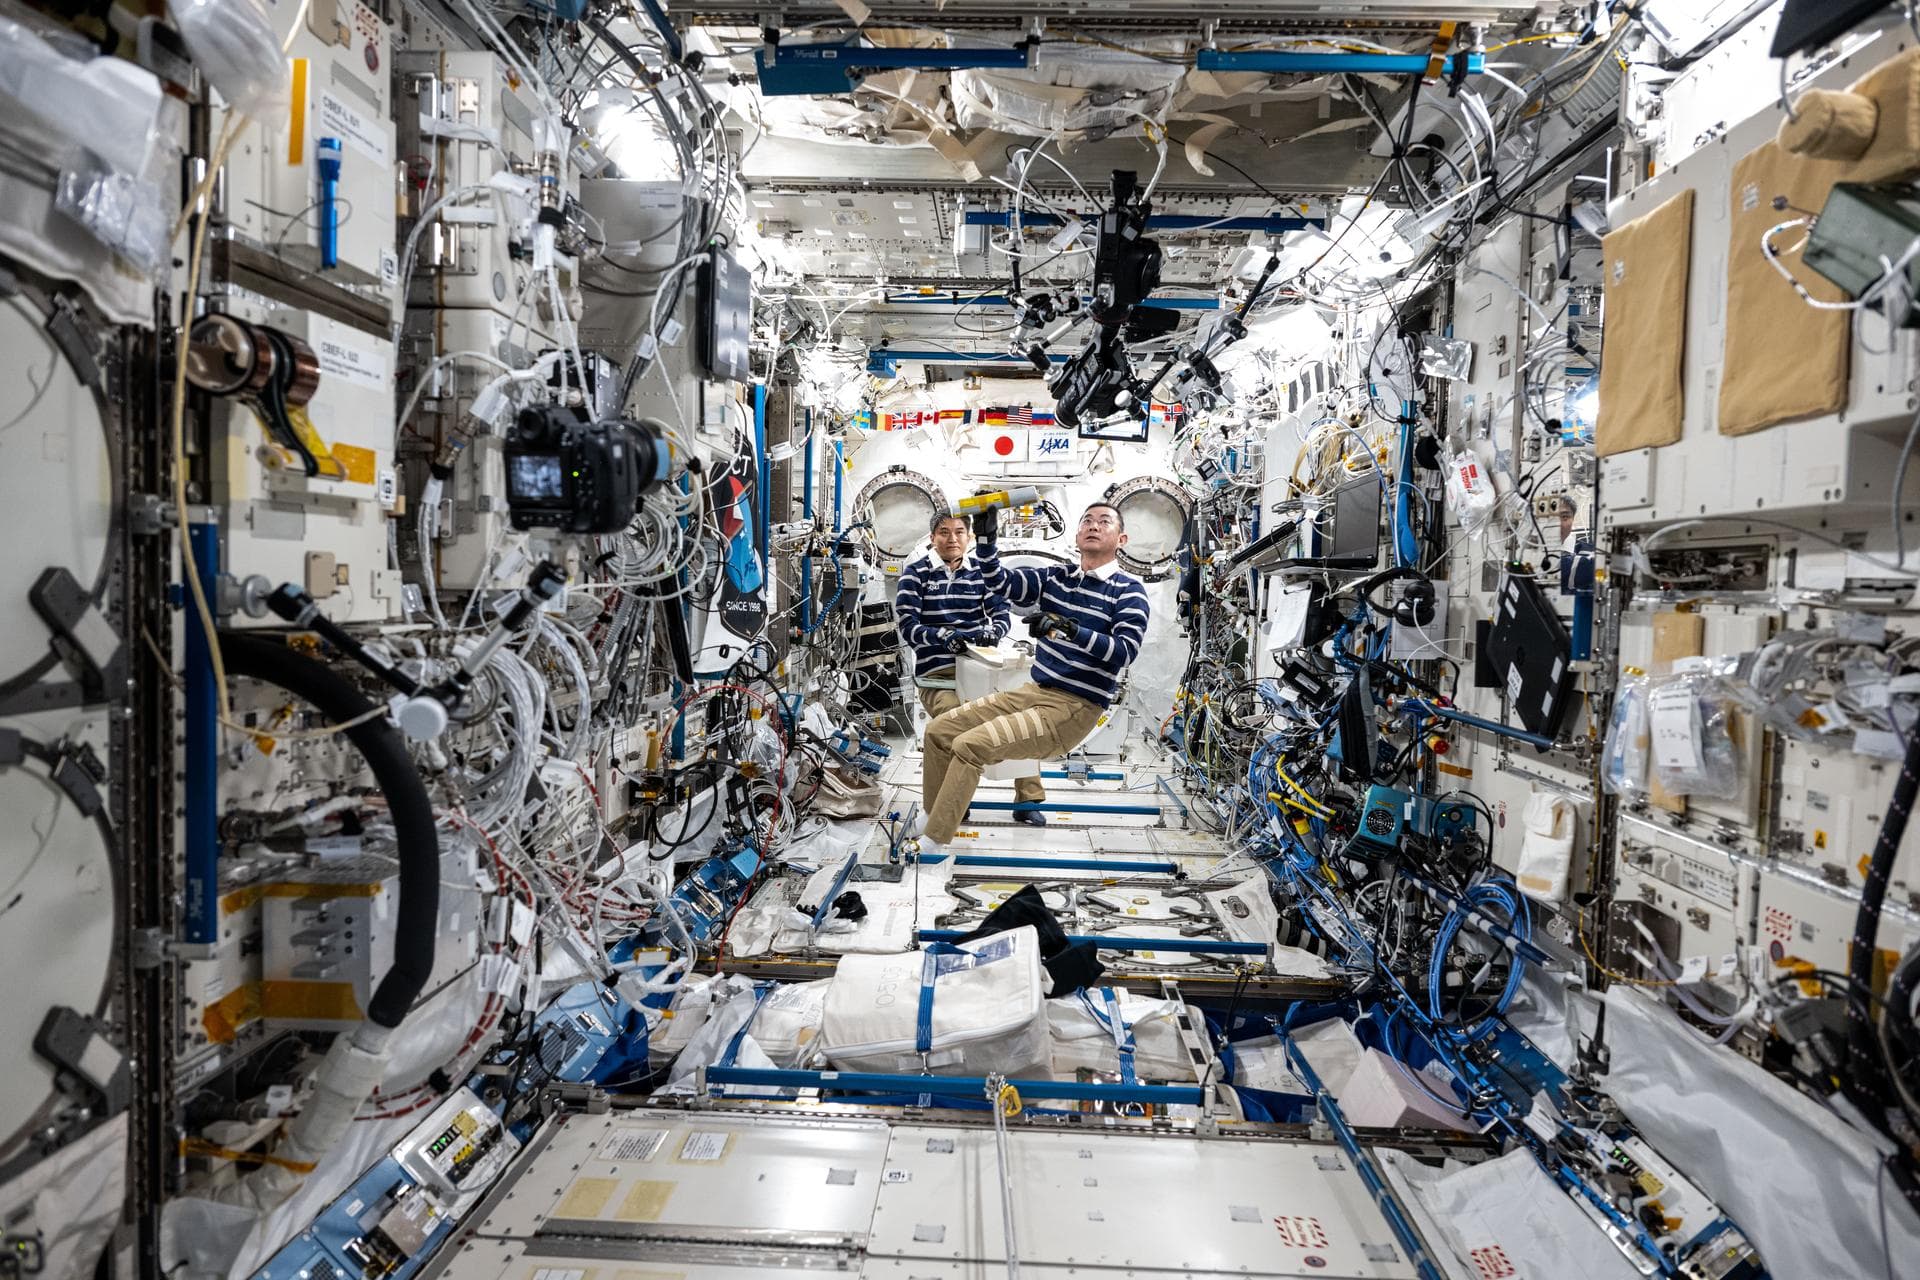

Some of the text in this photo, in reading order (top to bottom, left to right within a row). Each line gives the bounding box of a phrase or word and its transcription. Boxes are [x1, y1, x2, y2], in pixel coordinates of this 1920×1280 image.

[1036, 436, 1069, 457] JAXA
[726, 601, 761, 613] SINCE 1998
